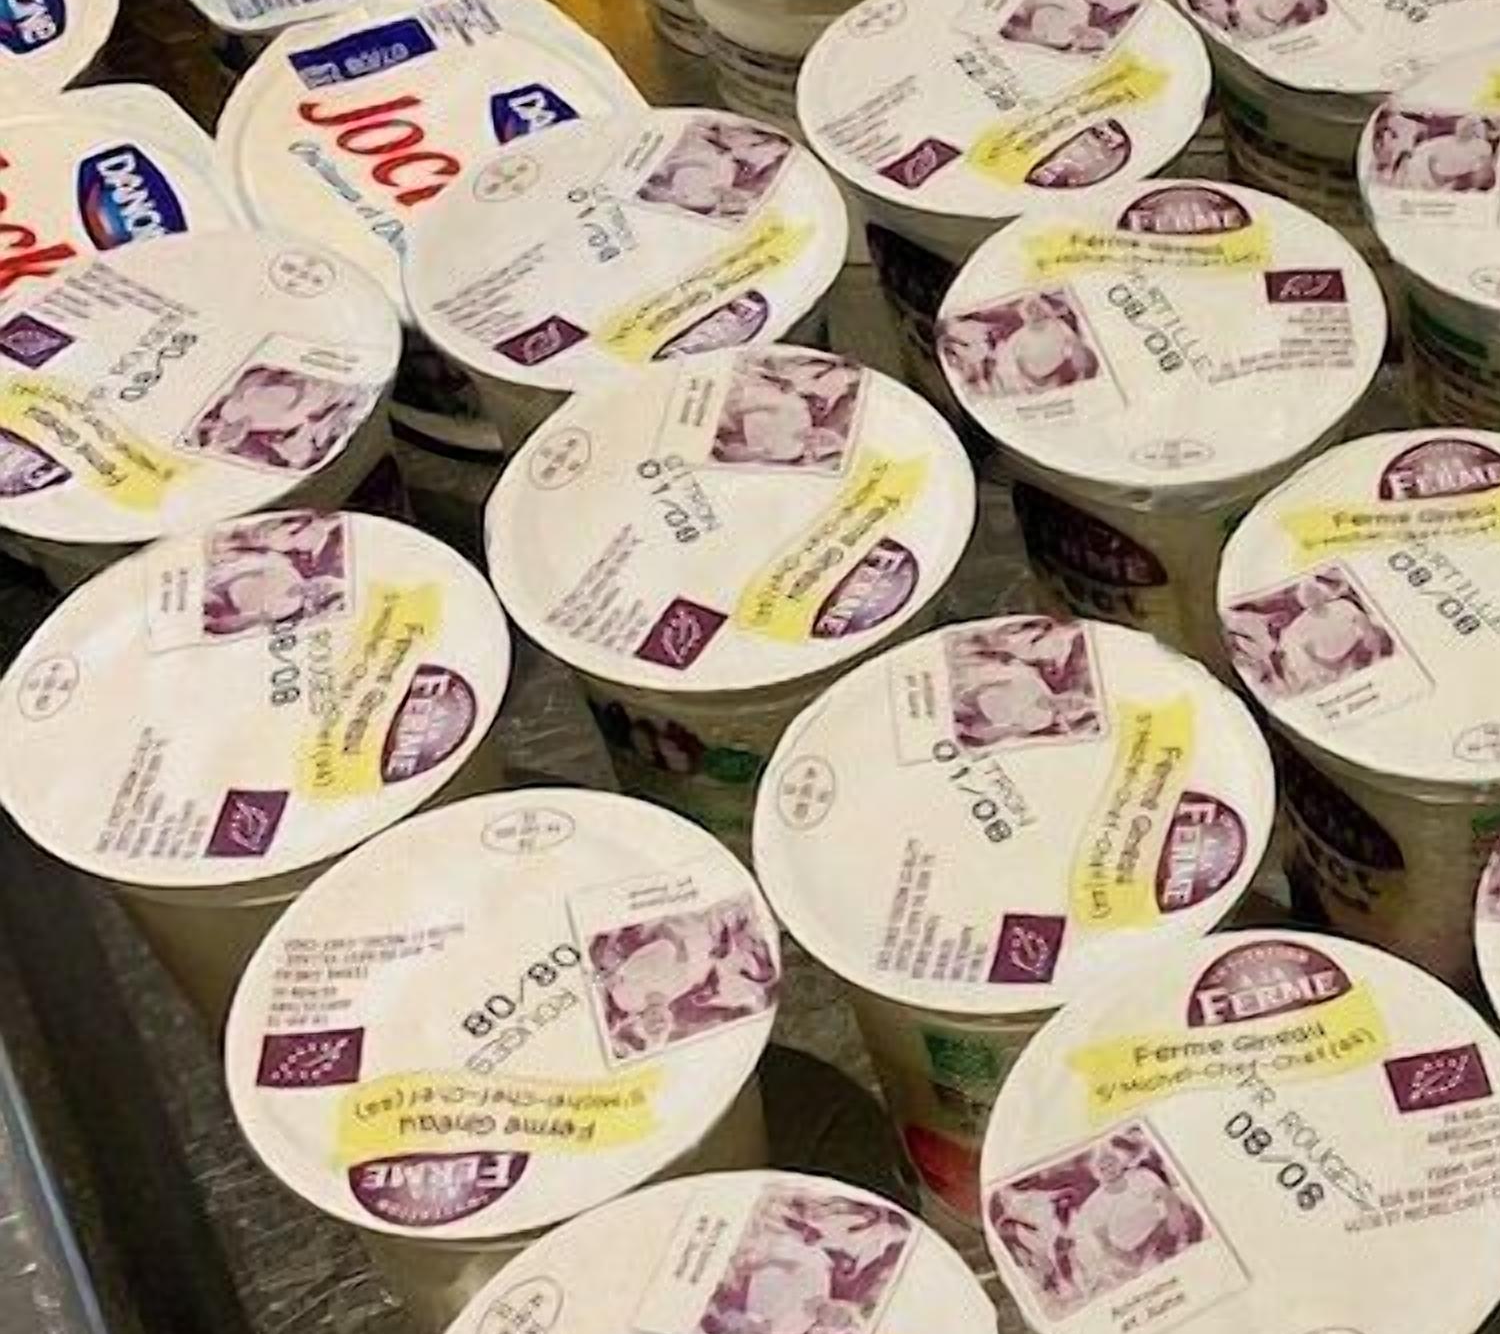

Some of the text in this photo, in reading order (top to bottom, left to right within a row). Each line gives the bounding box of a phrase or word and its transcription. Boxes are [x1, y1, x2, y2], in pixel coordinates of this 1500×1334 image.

[919, 735, 1023, 850] 01/08
[457, 937, 585, 1043] 08/08
[1195, 956, 1342, 1025] FERME
[1132, 1031, 1225, 1071] Ferme
[502, 1113, 595, 1139] Ferme
[356, 1157, 509, 1189] FERME
[1221, 1104, 1329, 1218] 08/08
